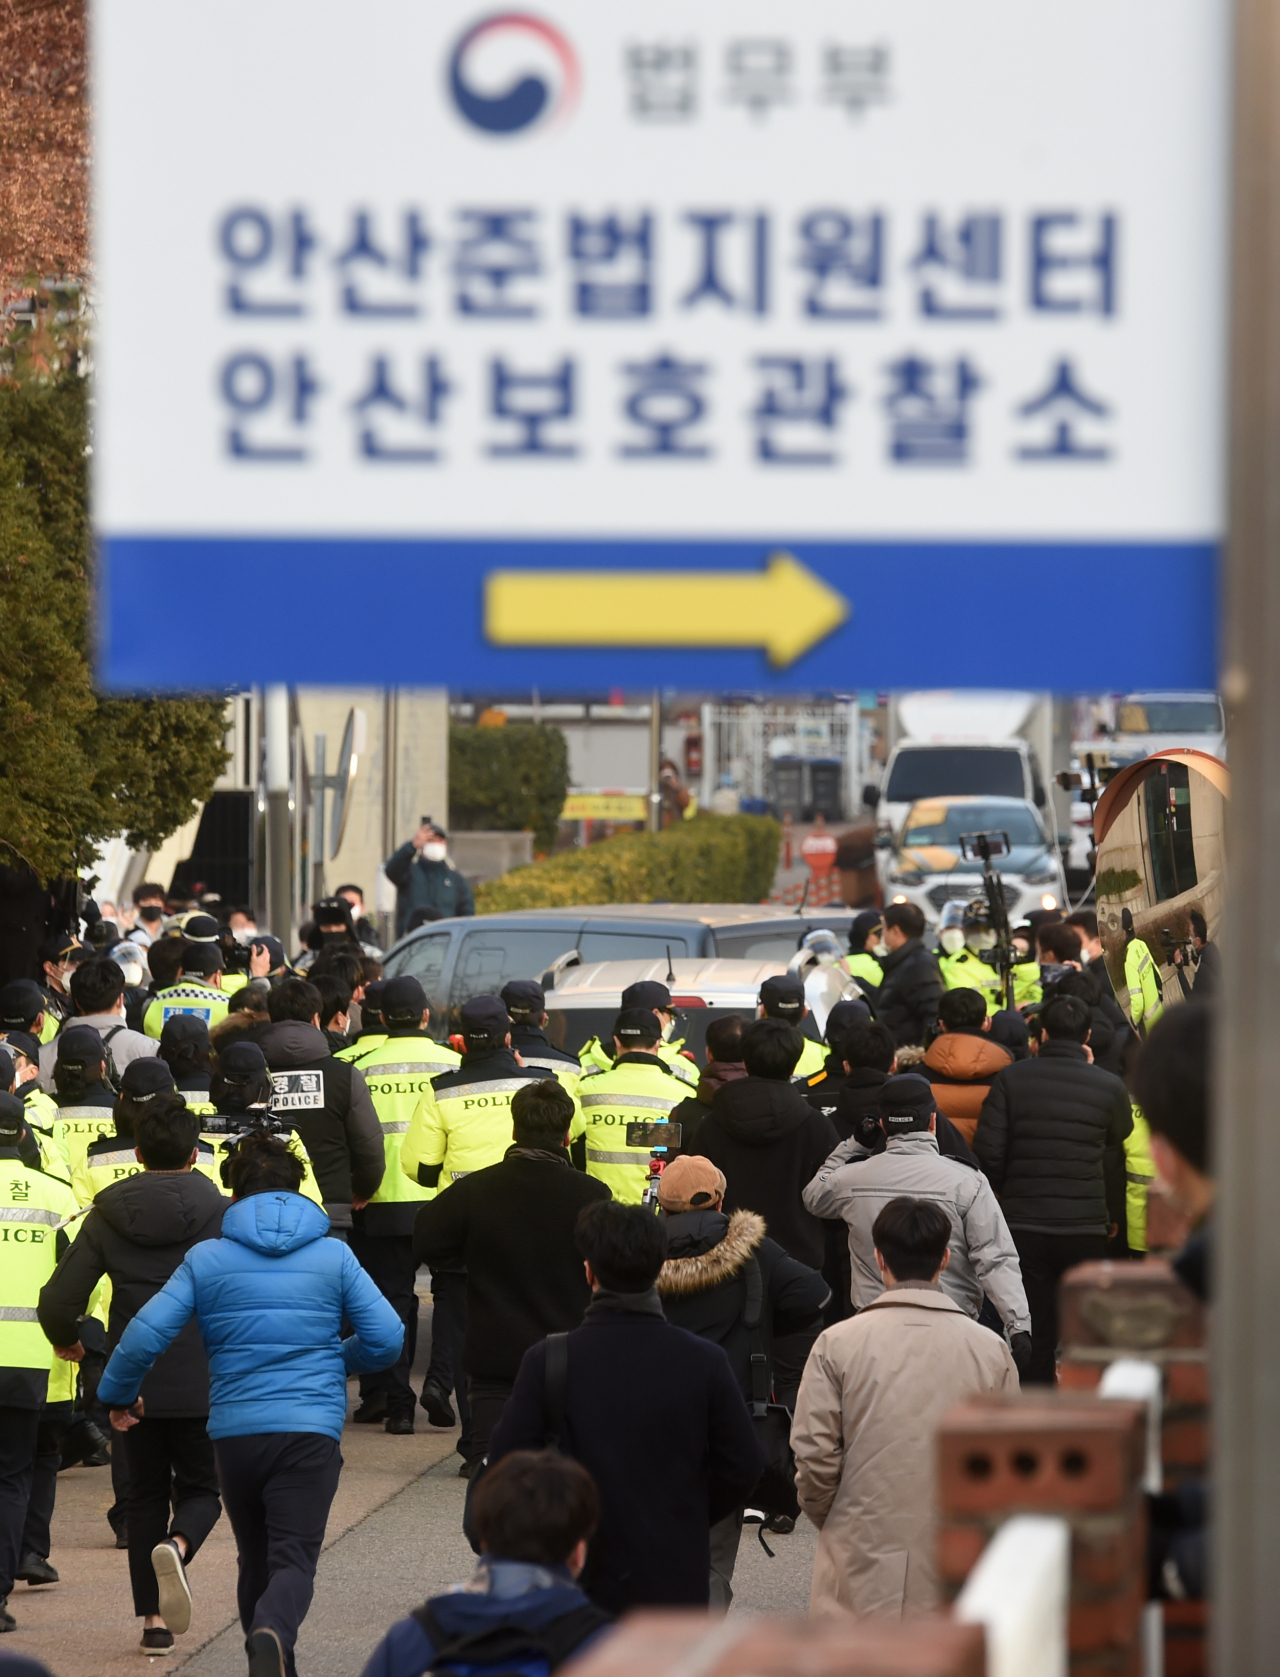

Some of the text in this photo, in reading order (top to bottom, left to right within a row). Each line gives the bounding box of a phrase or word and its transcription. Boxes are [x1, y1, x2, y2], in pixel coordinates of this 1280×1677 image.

[624, 36, 894, 121] 법무부
[214, 204, 1122, 321] 안산준법지원센터
[214, 350, 1117, 466] 안산보호관찰소
[273, 1094, 319, 1107] POLICE
[10, 1180, 31, 1201] 찰
